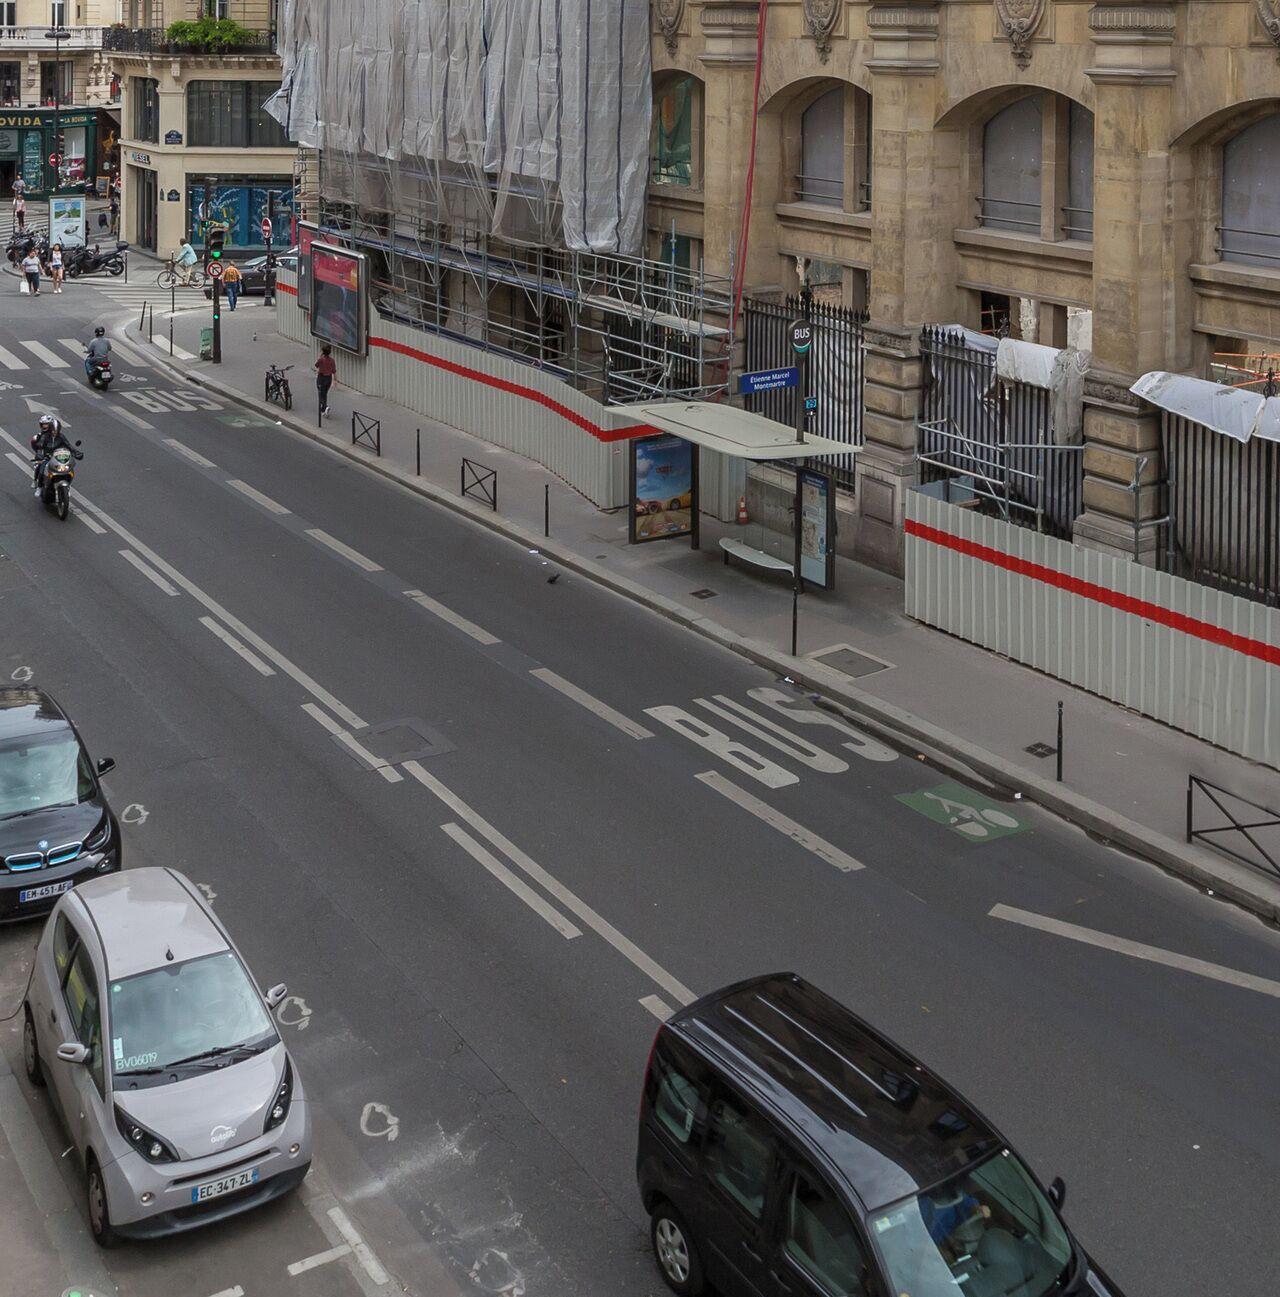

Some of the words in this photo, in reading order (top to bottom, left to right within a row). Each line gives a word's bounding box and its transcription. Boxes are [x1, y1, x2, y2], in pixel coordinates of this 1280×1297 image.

[794, 327, 810, 340] BUS
[750, 374, 771, 384] Étienne
[772, 371, 790, 380] Marcel
[754, 380, 786, 390] Montmartre
[120, 390, 224, 413] BUS
[642, 687, 900, 789] BUS
